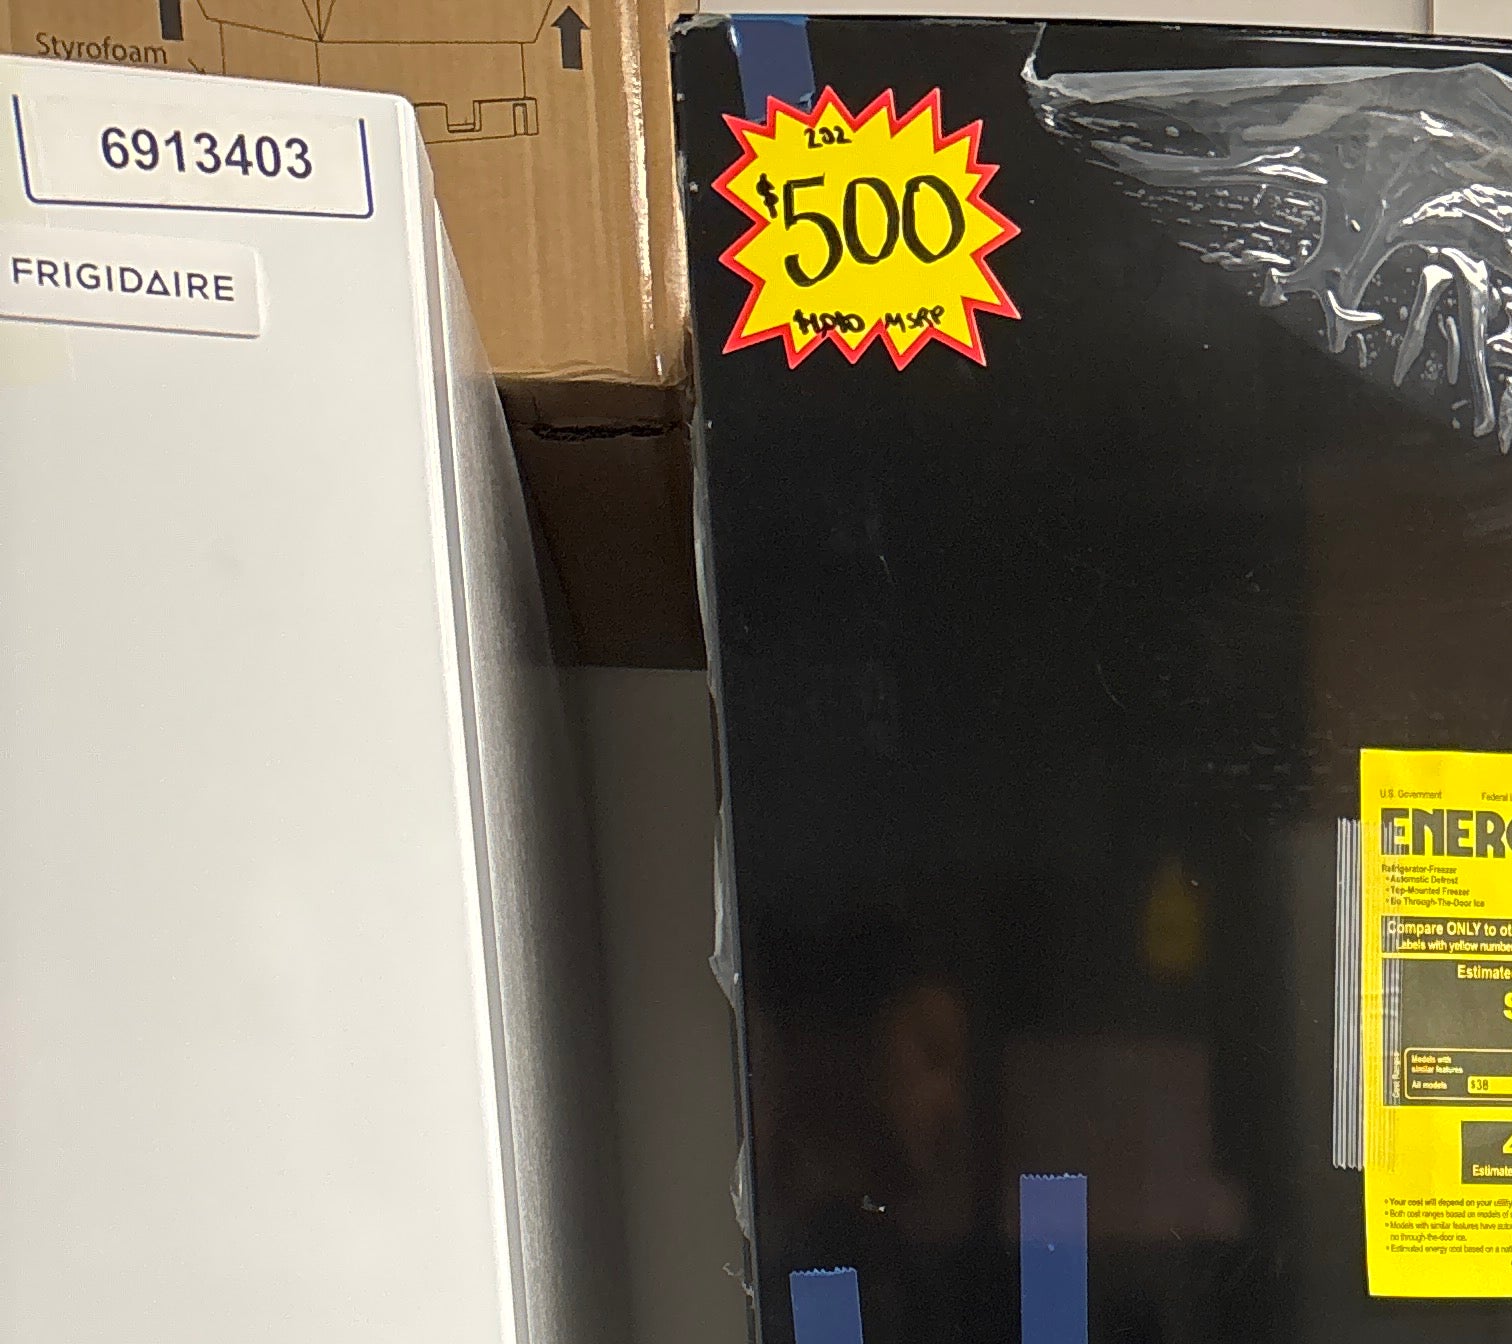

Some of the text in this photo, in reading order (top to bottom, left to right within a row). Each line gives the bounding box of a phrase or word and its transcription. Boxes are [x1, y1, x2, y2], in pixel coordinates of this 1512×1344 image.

[35, 32, 168, 66] Styrofoam
[100, 126, 313, 179] 6913403
[11, 256, 236, 302] FRIGIDAIRE
[1380, 789, 1442, 799] U.S. Government
[1386, 919, 1443, 938] Compare
[1446, 920, 1481, 936] ONLY
[1483, 923, 1496, 936] to
[1395, 939, 1426, 951] Labels
[1427, 940, 1447, 950] with
[1448, 940, 1478, 954] yellow
